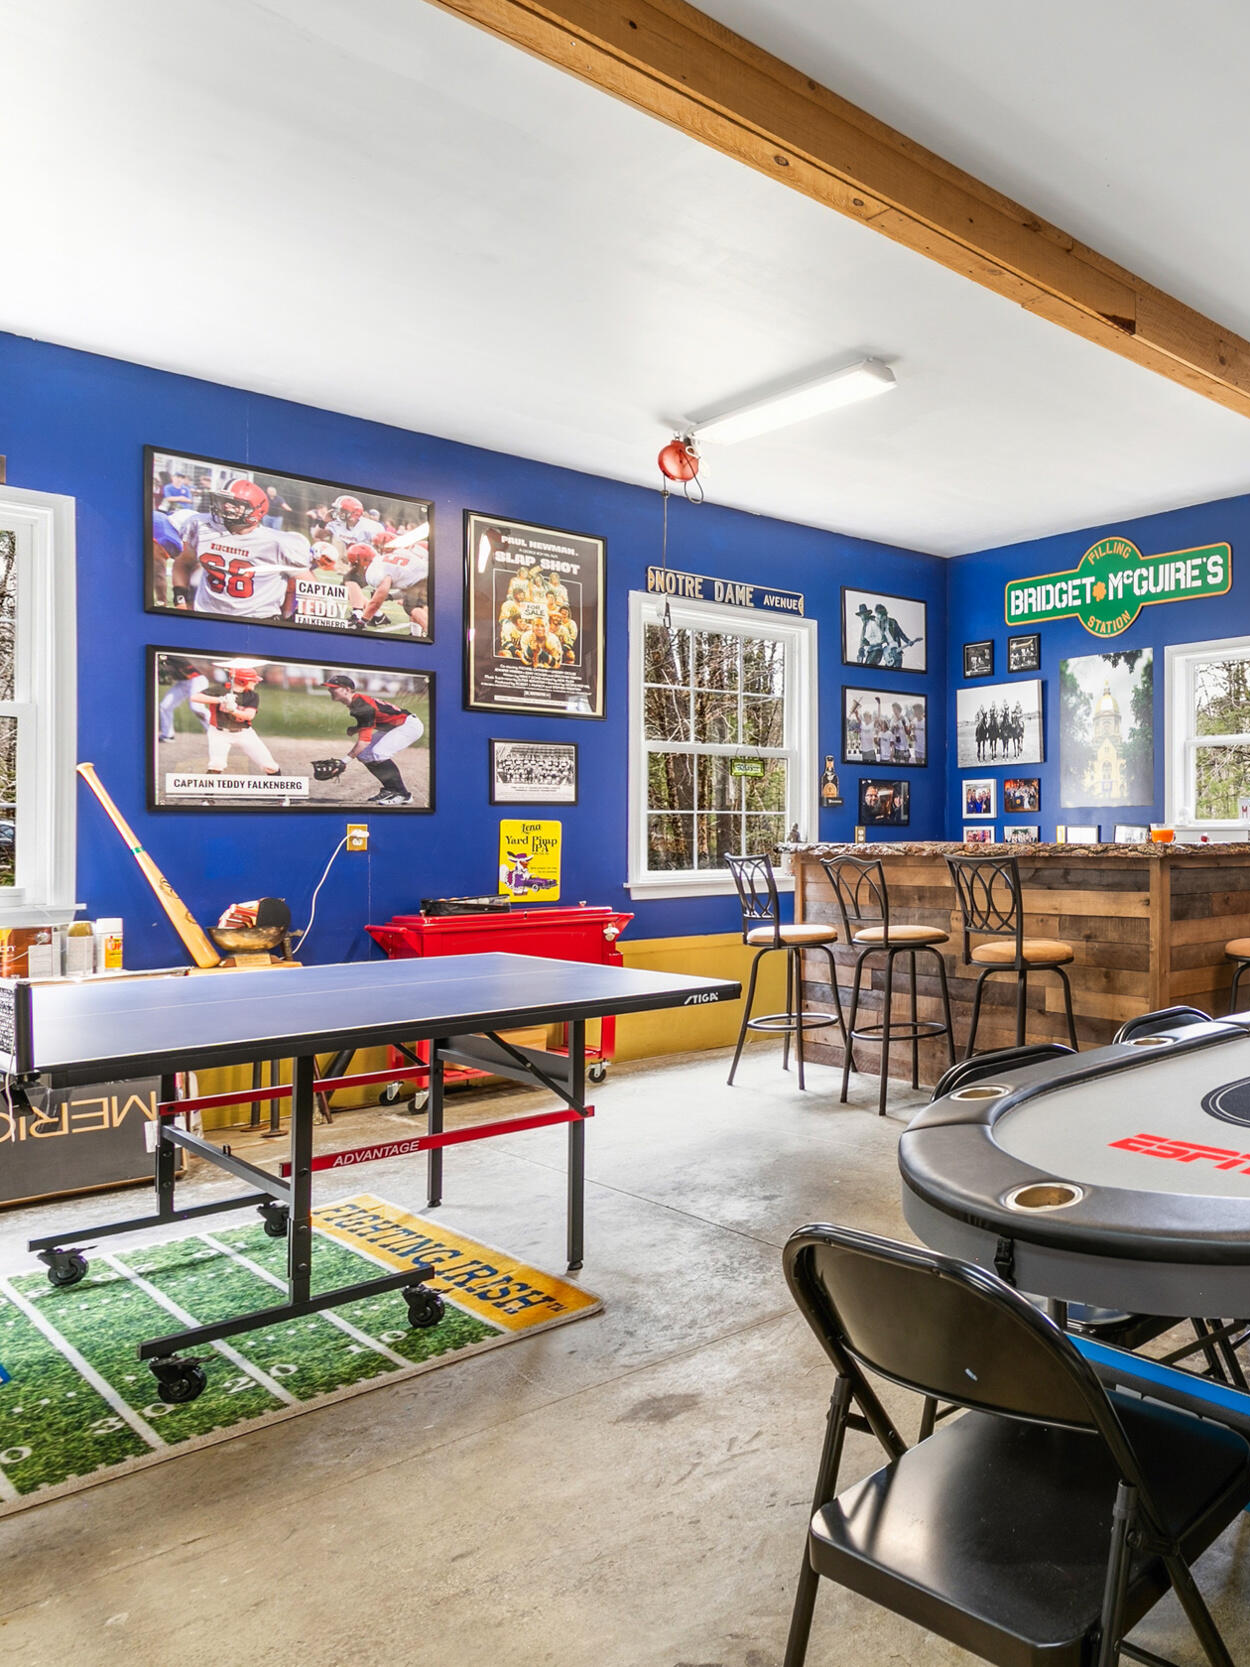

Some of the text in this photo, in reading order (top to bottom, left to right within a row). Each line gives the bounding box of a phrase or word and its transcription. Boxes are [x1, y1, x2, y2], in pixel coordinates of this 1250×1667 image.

[501, 535, 528, 547] PAUL
[494, 550, 536, 567] SLAP
[540, 558, 581, 575] SHOT
[1087, 541, 1132, 566] FILLING
[298, 581, 346, 599] CAPTAIN
[655, 570, 799, 611] NOTRE DAME AVENUE
[1010, 576, 1096, 616] BRIDGET
[297, 599, 349, 619] TEDDY
[1087, 610, 1131, 634] STATION
[173, 778, 303, 790] CAPTAIN TEDDY FALKENBERG
[521, 823, 542, 834] Lena
[505, 835, 558, 848] Yard Pimp
[531, 843, 550, 853] IPA
[684, 991, 719, 1005] STIGA
[333, 1140, 420, 1167] ADVANTAGE
[313, 1203, 464, 1276] FIGHTING
[434, 1258, 557, 1315] IRISH
